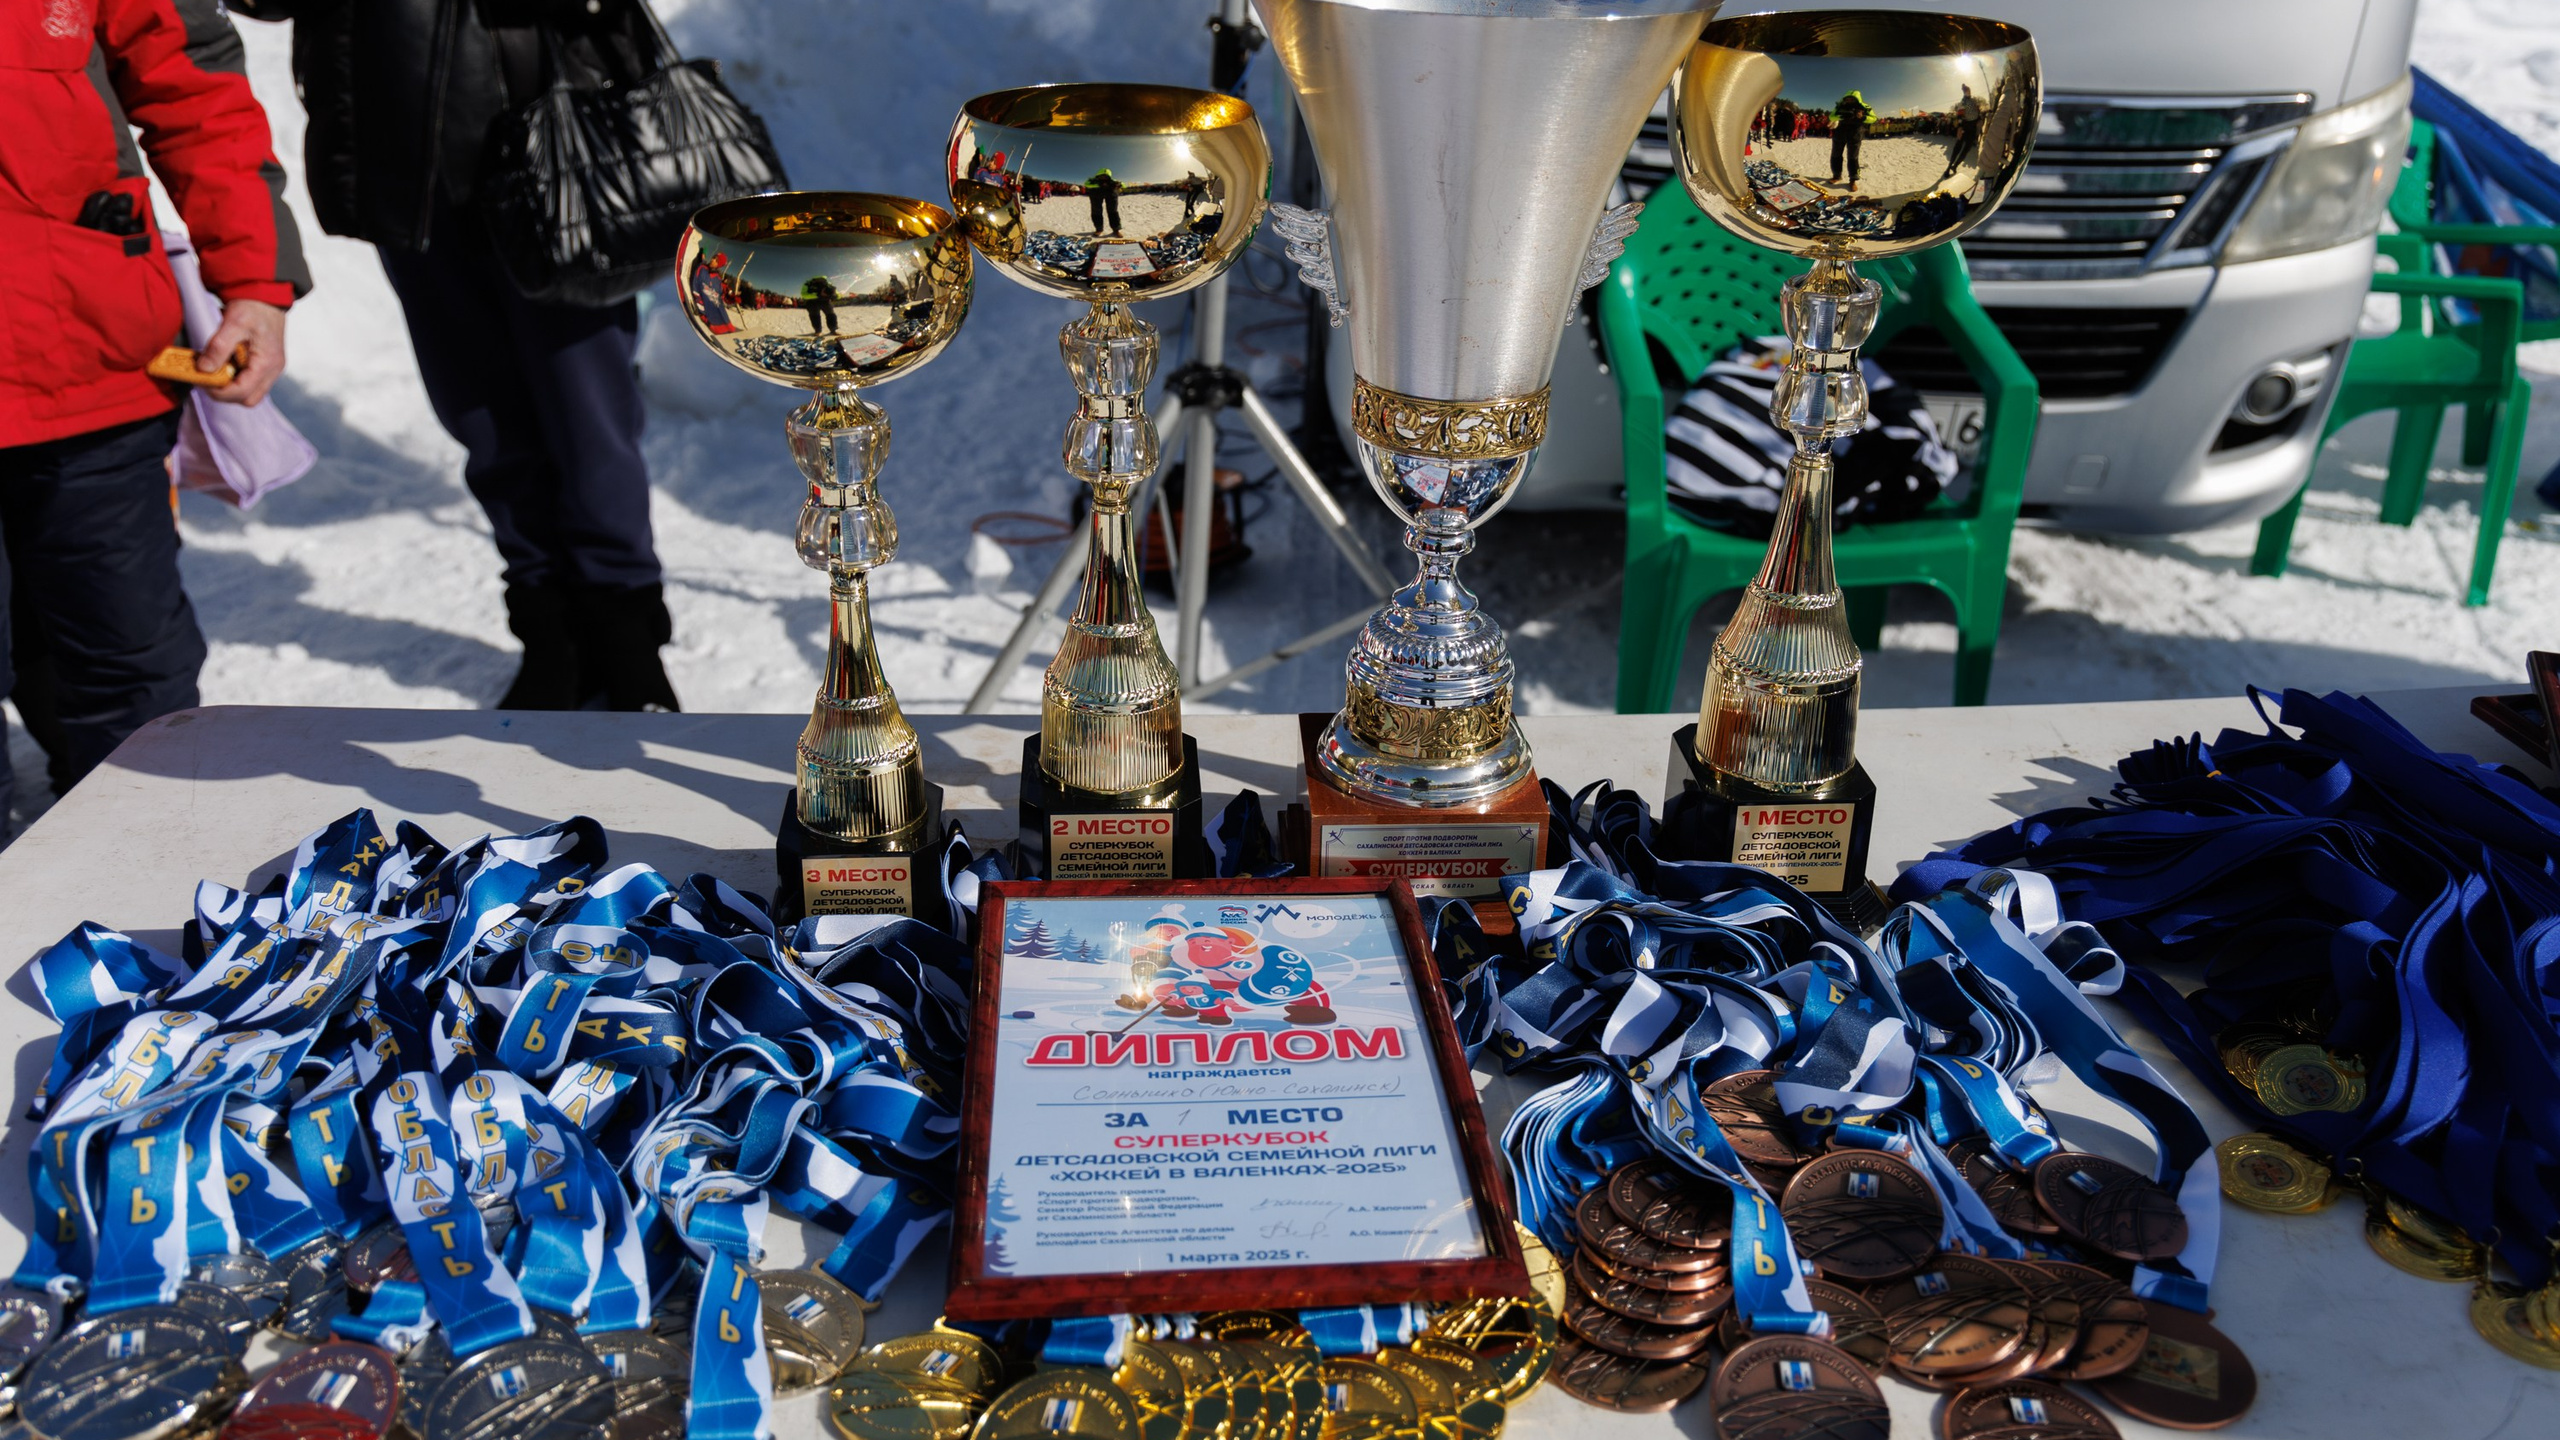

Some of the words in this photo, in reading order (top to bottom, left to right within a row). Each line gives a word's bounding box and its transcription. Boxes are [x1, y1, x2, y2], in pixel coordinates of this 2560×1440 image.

[1742, 811, 1750, 826] 1
[1758, 809, 1848, 826] МЕСТО
[1053, 820, 1069, 835] 2
[1077, 819, 1170, 835] МЕСТО
[1751, 831, 1834, 840] СУПЕРКУБОК
[1069, 841, 1154, 850] СУПЕРКУБОК
[1740, 839, 1841, 851] ДЕТСАДОВСКОЙ
[1059, 850, 1164, 860] ДЕТСАДОВСКОЙ
[1737, 851, 1806, 861] СЕМЕЙНОЙ
[1809, 852, 1842, 860] ЛИГИ
[1057, 861, 1129, 872] СЕМЕЙНОЙ
[1132, 863, 1166, 871] ЛИГИ
[1368, 861, 1489, 877] СУПЕРКУБОК
[807, 870, 820, 883] 3
[828, 868, 907, 882] МЕСТО
[820, 888, 896, 896] СУПЕРКУБОК
[812, 896, 904, 906] ДЕТСАДОВСКОЙ
[811, 906, 874, 915] СЕМЕЙНОЙ
[1307, 913, 1377, 921] МОЛОДЁЖЬ
[1024, 1027, 1404, 1066] ДИПЛОМ
[1148, 1067, 1292, 1081] награждается
[1104, 1112, 1149, 1128] ЗА
[1177, 1109, 1191, 1126] 1
[1227, 1107, 1343, 1126] МЕСТО
[1114, 1130, 1329, 1149] СУПЕРКУБОК
[1015, 1149, 1219, 1166] ДЕТСАДОВСКОЙ
[1227, 1145, 1365, 1161] СЕМЕЙНОЙ
[1373, 1145, 1436, 1157] ЛИГИ
[1050, 1166, 1160, 1182] «ХОККЕЙ
[1169, 1168, 1185, 1179] В
[1194, 1162, 1406, 1179] ВАЛЕНКАХ-2025»
[1802, 1159, 1880, 1189] САХАЛИНСКАЯ
[1884, 1165, 1925, 1198] ОБЛАСТЬ
[1167, 1253, 1174, 1263] 1
[1181, 1253, 1239, 1264] марта
[1245, 1250, 1290, 1260] 2025
[1296, 1251, 1309, 1259] г.
